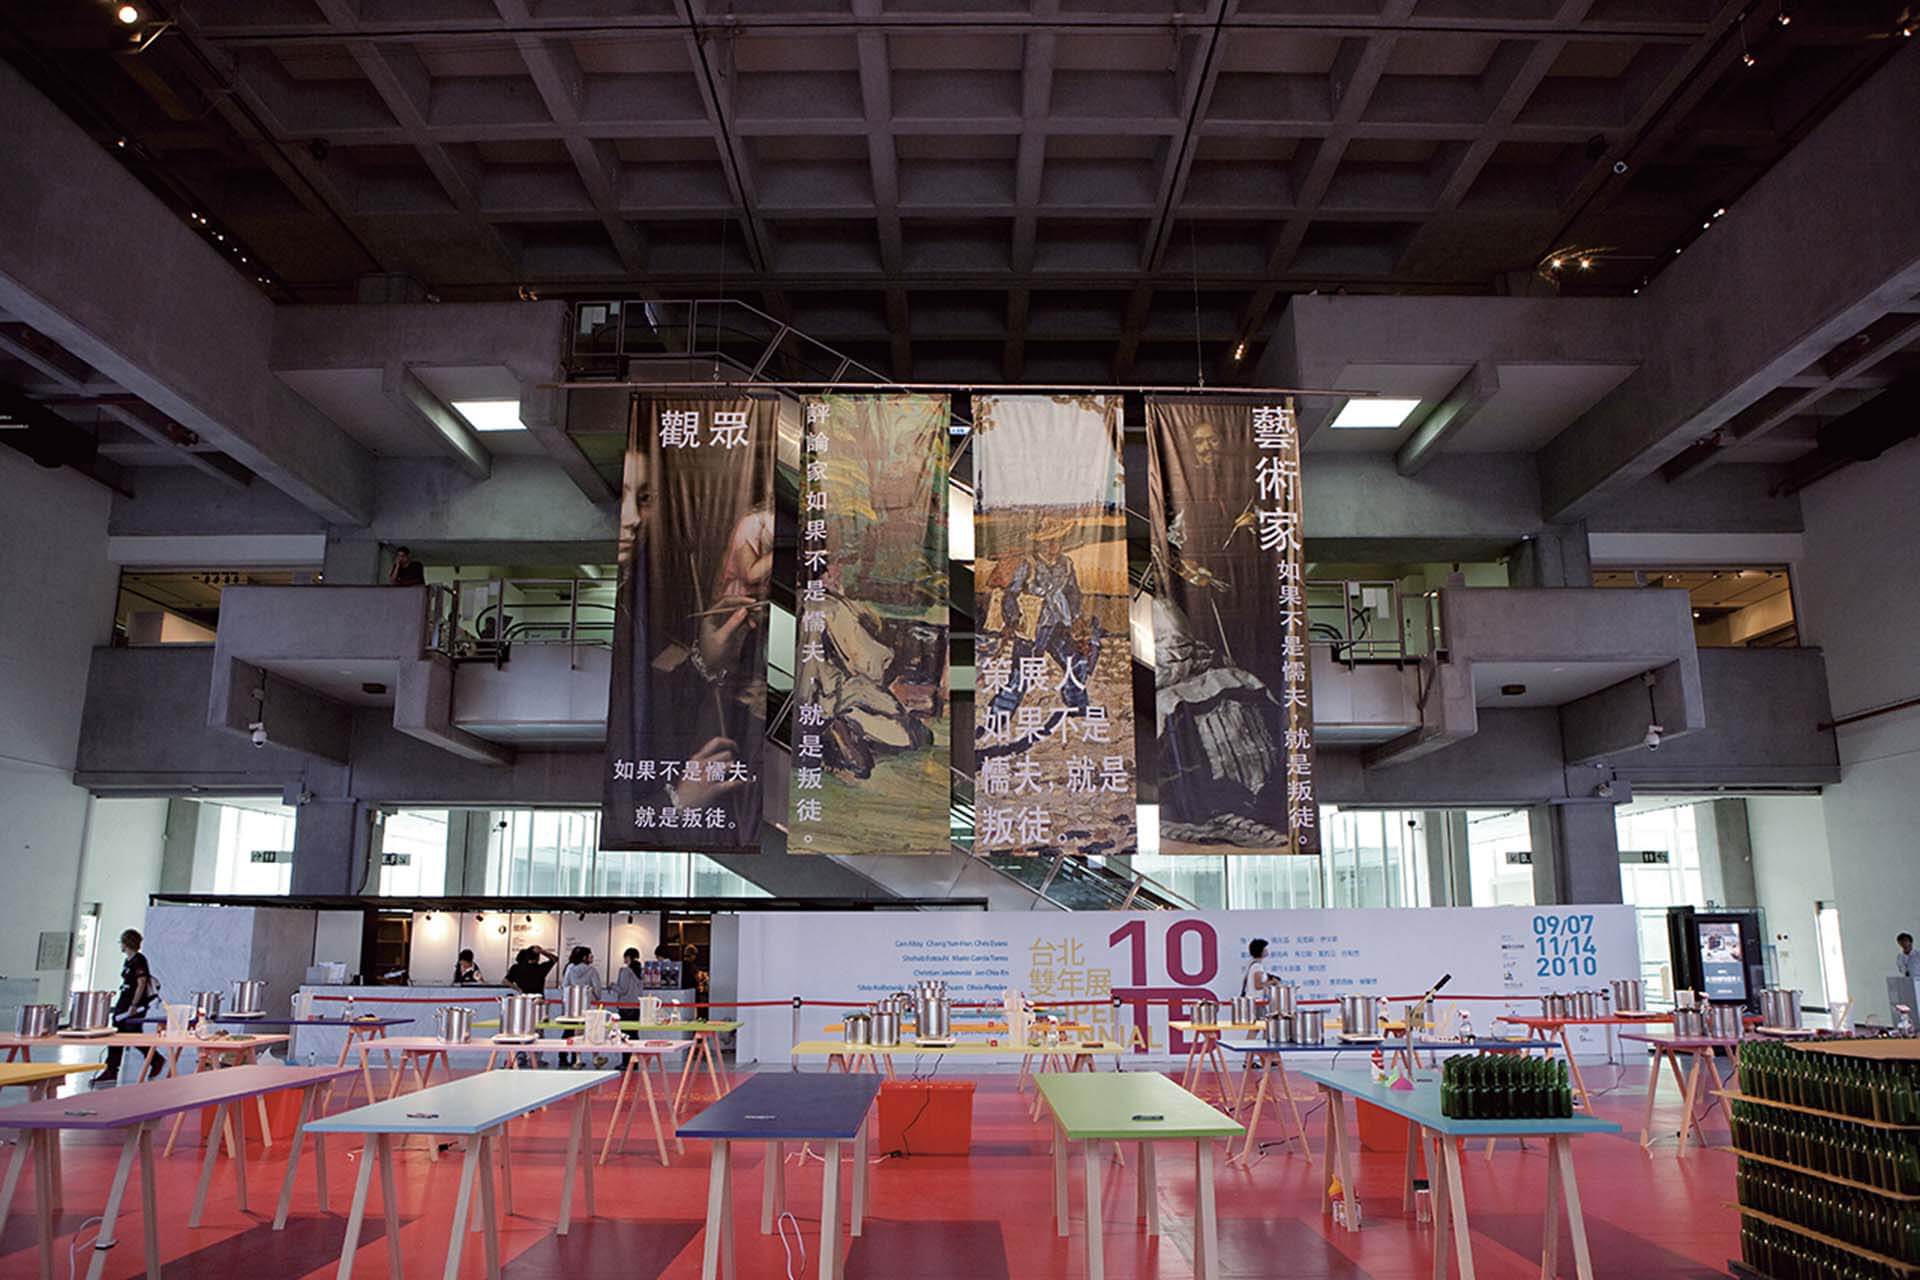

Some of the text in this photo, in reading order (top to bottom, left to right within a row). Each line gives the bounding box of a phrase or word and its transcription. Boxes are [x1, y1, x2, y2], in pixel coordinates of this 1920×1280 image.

[659, 409, 749, 449] 觀眾
[1252, 405, 1301, 553] 藝術家
[981, 655, 1086, 694] 策展人
[980, 706, 1111, 744] 如果不是
[634, 805, 737, 830] 就是叛徒。
[981, 806, 1068, 845] 叛徒。
[1533, 914, 1594, 936] 09/07
[1029, 936, 1085, 966] 台北
[1109, 919, 1218, 986] 10
[1536, 936, 1597, 956] 11/14
[1029, 967, 1112, 998] 雙年展
[1536, 957, 1597, 976] 2010
